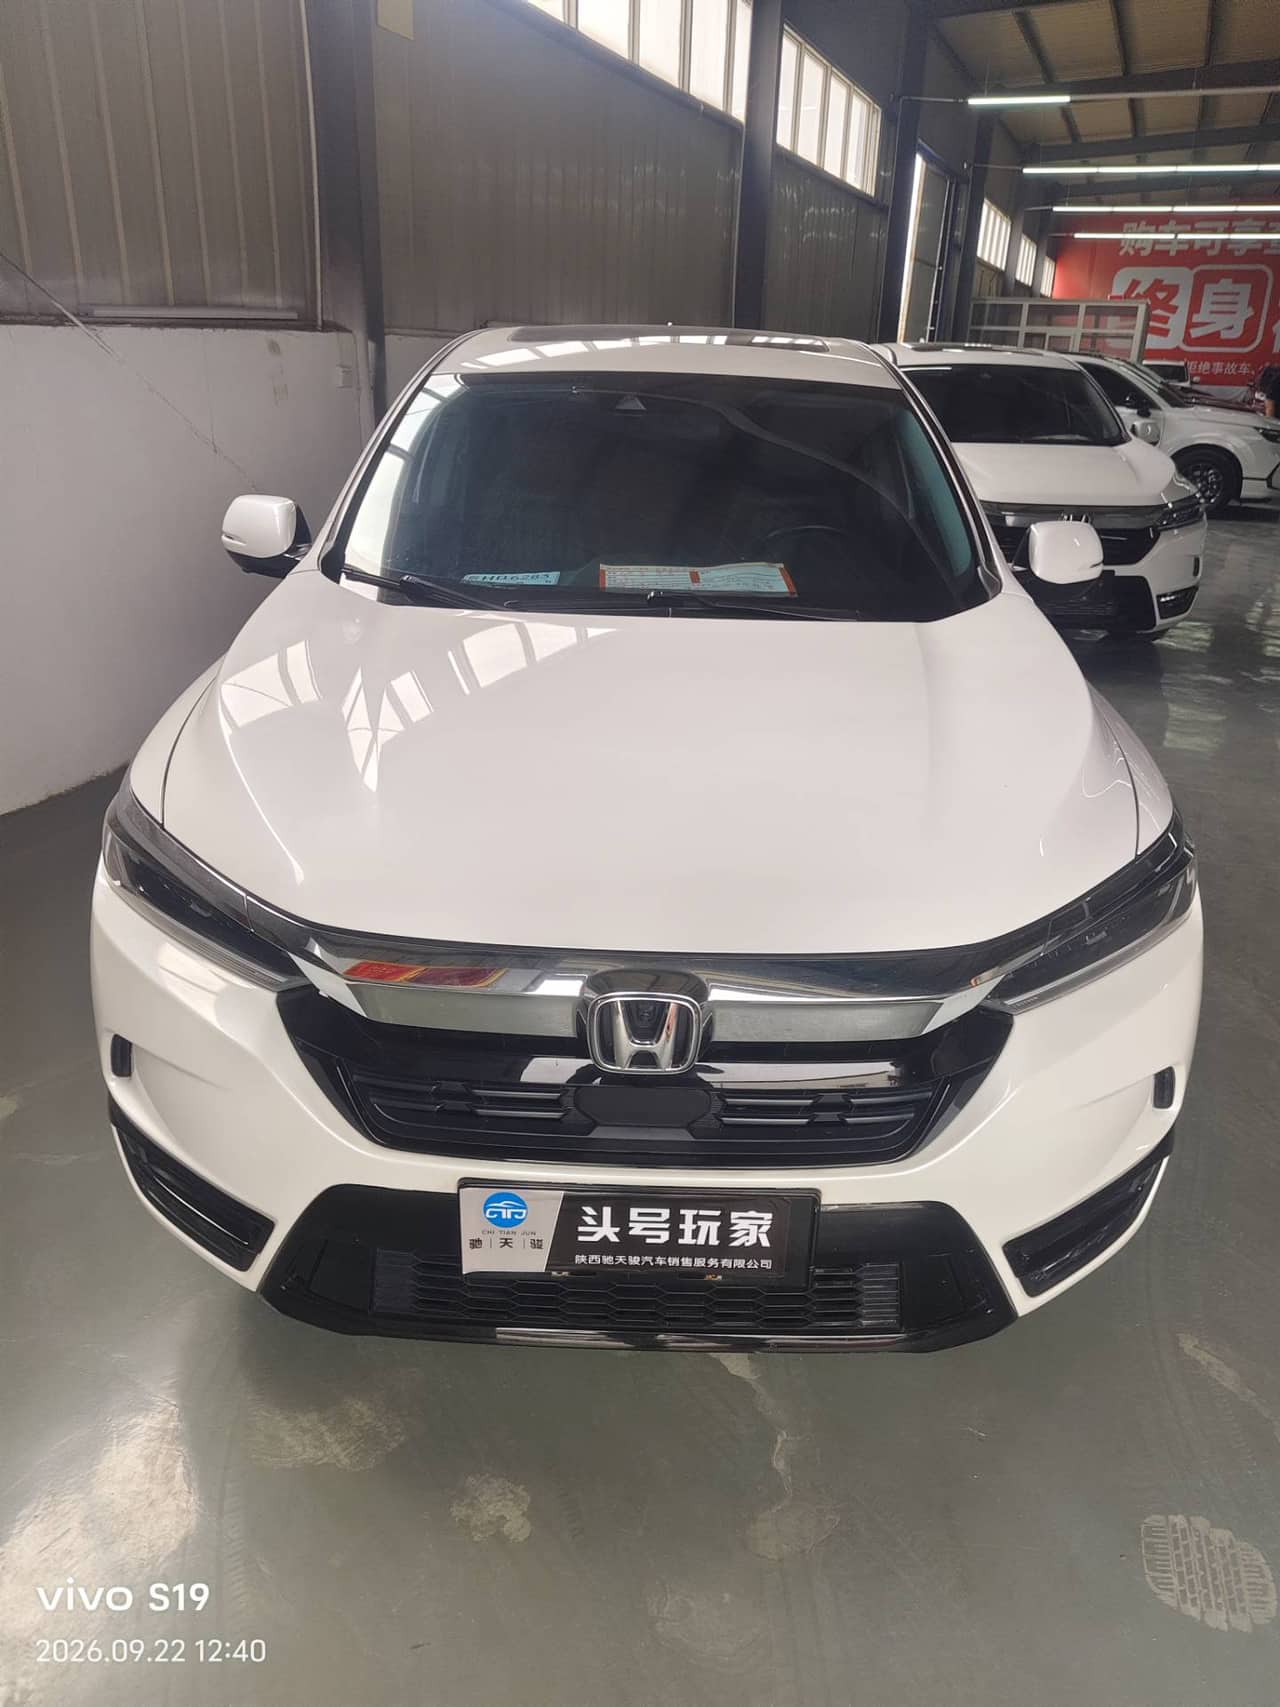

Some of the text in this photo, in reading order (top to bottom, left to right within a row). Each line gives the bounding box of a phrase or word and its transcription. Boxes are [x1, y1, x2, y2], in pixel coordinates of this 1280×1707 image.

[577, 1206, 772, 1248] 头号玩家
[575, 1254, 772, 1269] 陕西驰天骏汽车销售服务有限公司
